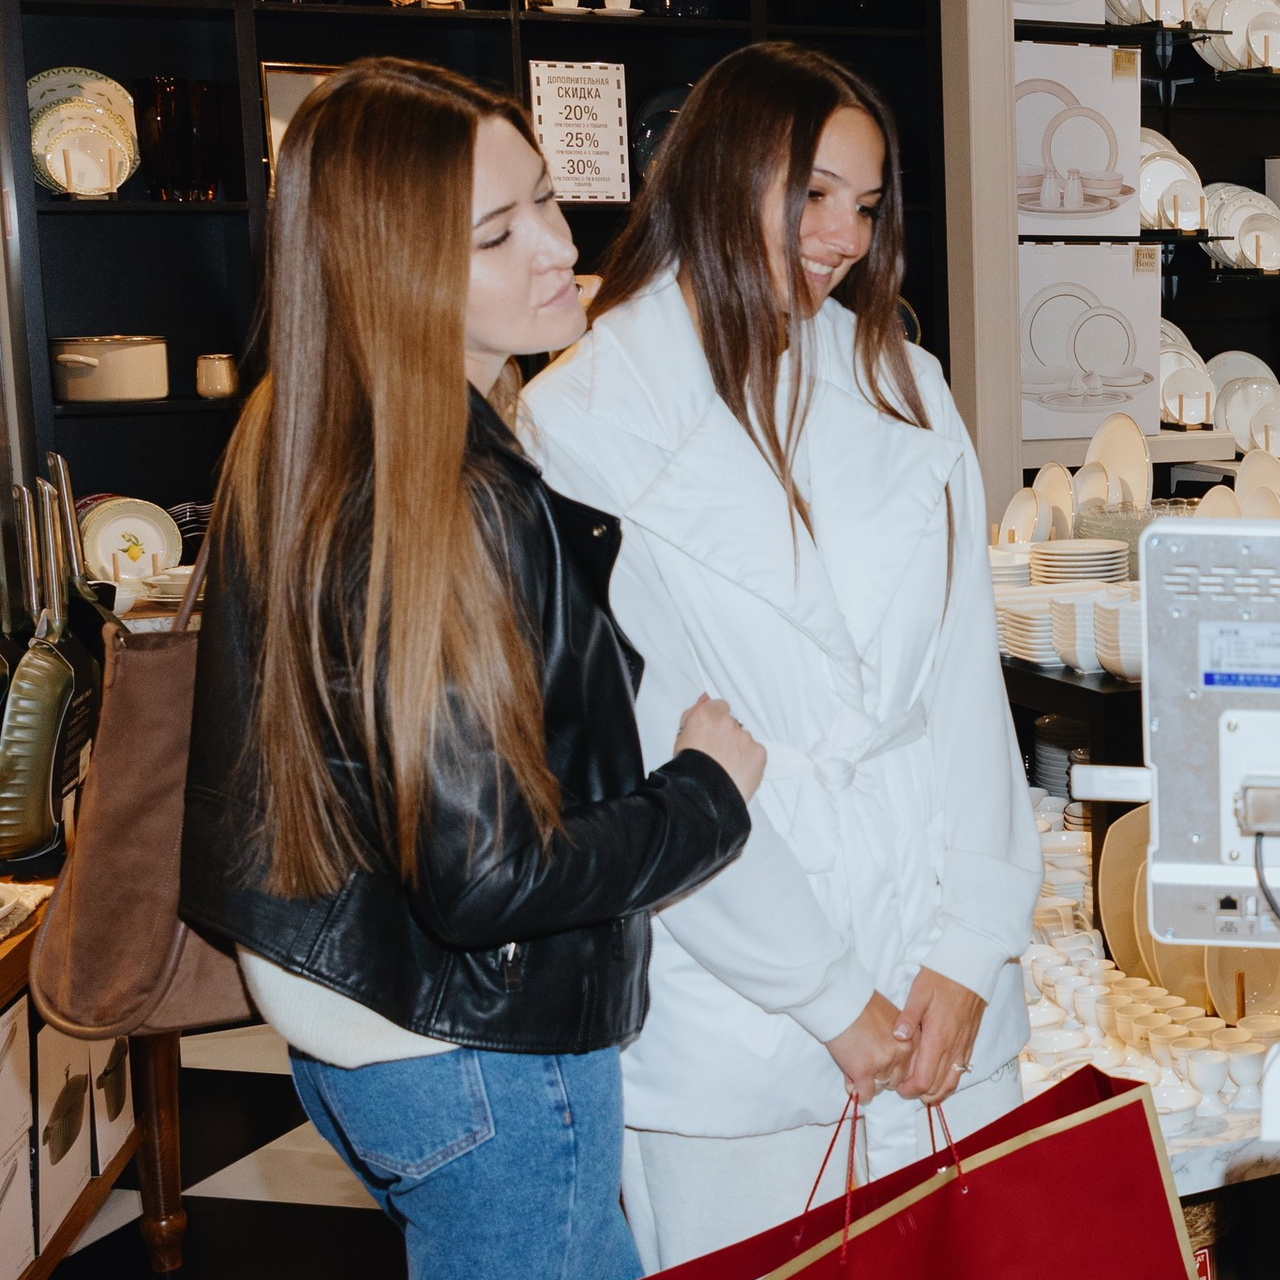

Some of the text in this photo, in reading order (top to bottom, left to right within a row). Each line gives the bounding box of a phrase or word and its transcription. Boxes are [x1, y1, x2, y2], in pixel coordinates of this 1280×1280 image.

[547, 76, 610, 86] ДОПОЛНИТЕЛЬНАЯ
[557, 86, 602, 101] СКИДКА
[558, 104, 598, 121] -20%
[560, 131, 599, 148] -25%
[561, 158, 601, 175] -30%
[1136, 249, 1156, 259] Fine
